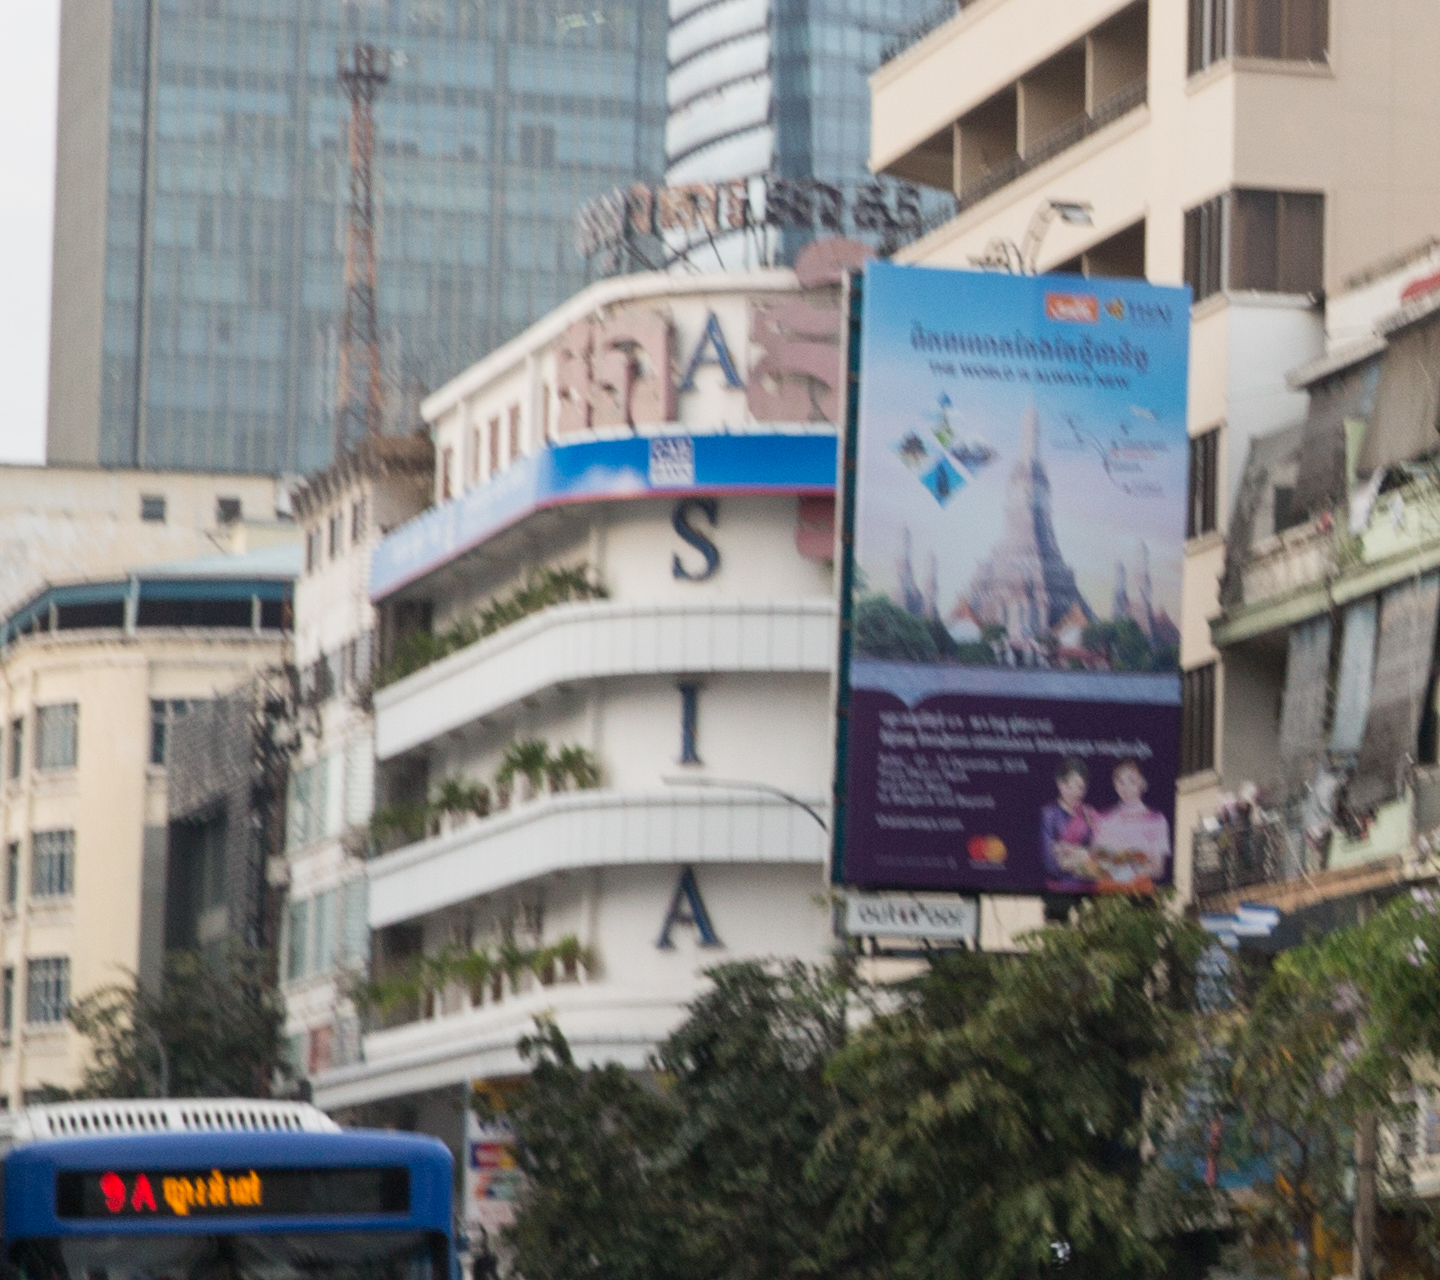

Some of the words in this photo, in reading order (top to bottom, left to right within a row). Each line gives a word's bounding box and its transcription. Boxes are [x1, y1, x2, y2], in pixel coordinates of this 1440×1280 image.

[928, 360, 956, 378] THE
[960, 362, 1014, 382] WORLD
[1035, 368, 1092, 388] ALWAYS
[1094, 372, 1130, 389] NEW
